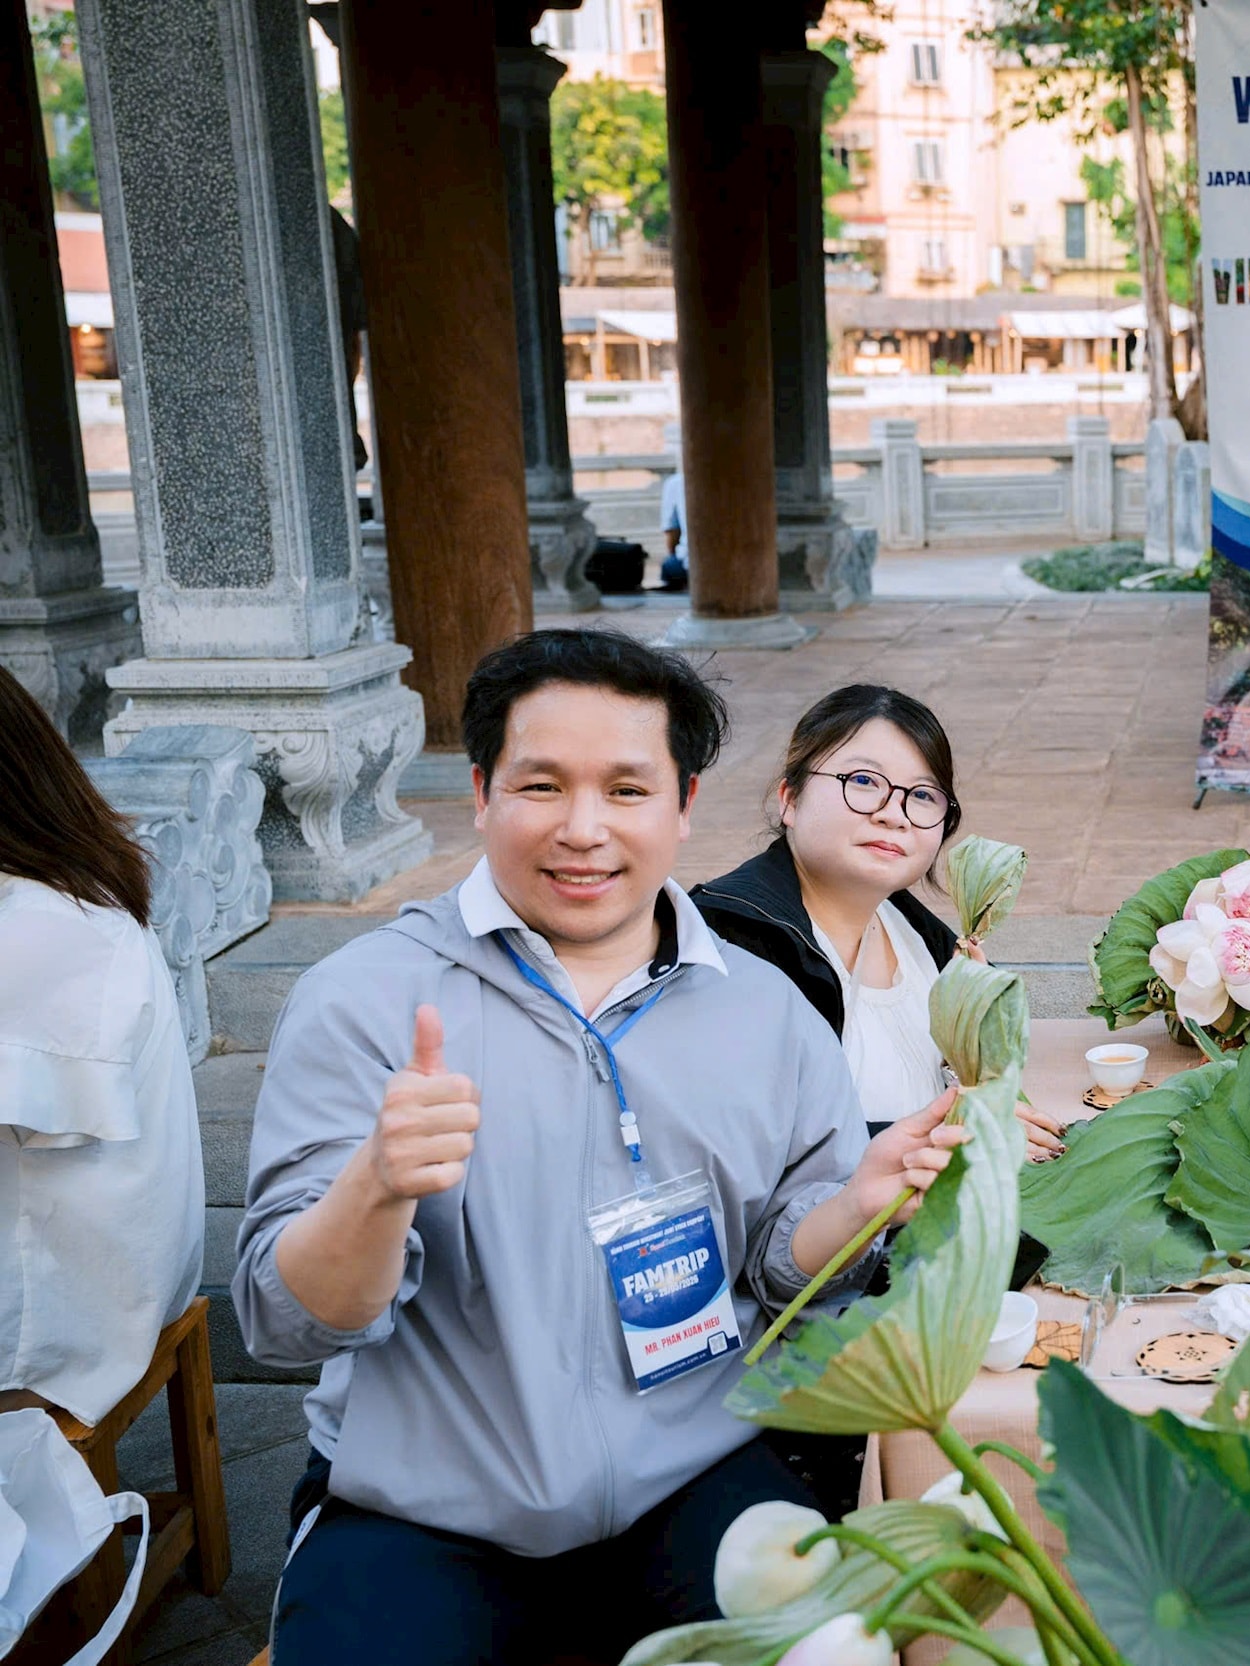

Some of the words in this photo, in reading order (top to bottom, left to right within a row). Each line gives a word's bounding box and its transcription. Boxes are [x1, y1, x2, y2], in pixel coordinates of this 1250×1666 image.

[621, 1247, 710, 1298] FAMTRIP
[644, 1341, 659, 1356] MR.
[662, 1333, 682, 1348] PHAN
[683, 1325, 703, 1340] XUAN
[703, 1315, 720, 1330] HIEU
